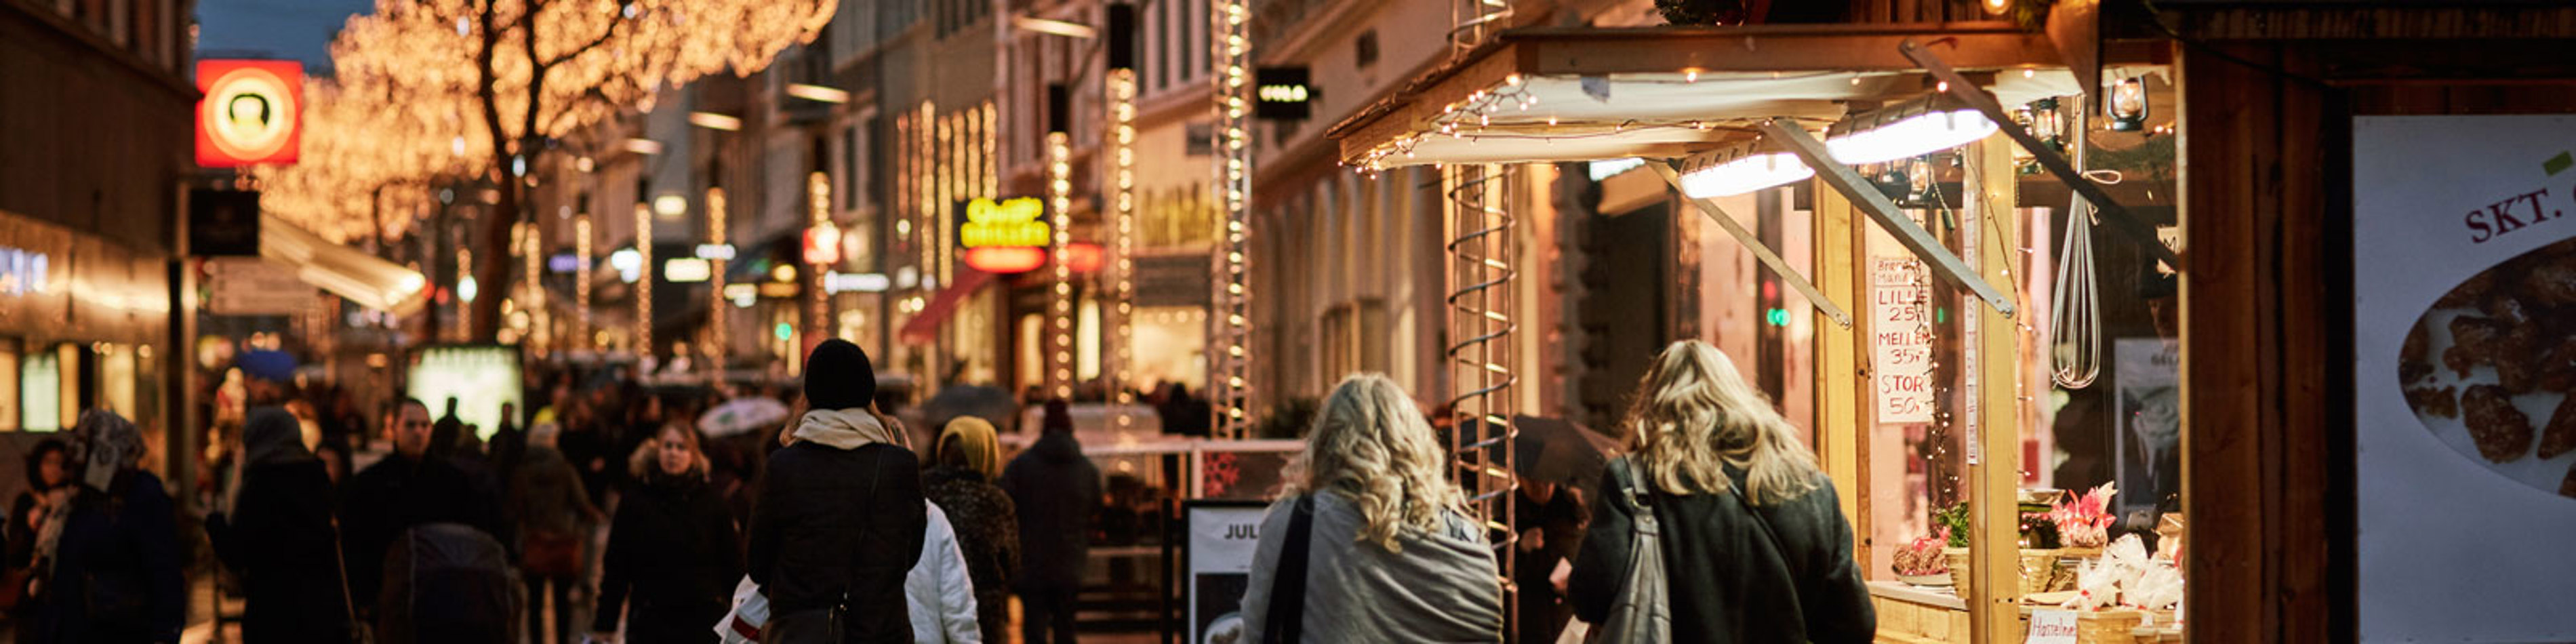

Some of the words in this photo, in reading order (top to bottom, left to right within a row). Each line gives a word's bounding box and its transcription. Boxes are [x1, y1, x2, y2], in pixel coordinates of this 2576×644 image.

[2466, 188, 2562, 244] SKT.
[1878, 290, 1927, 305] LILLE
[1882, 374, 1924, 394] STOR
